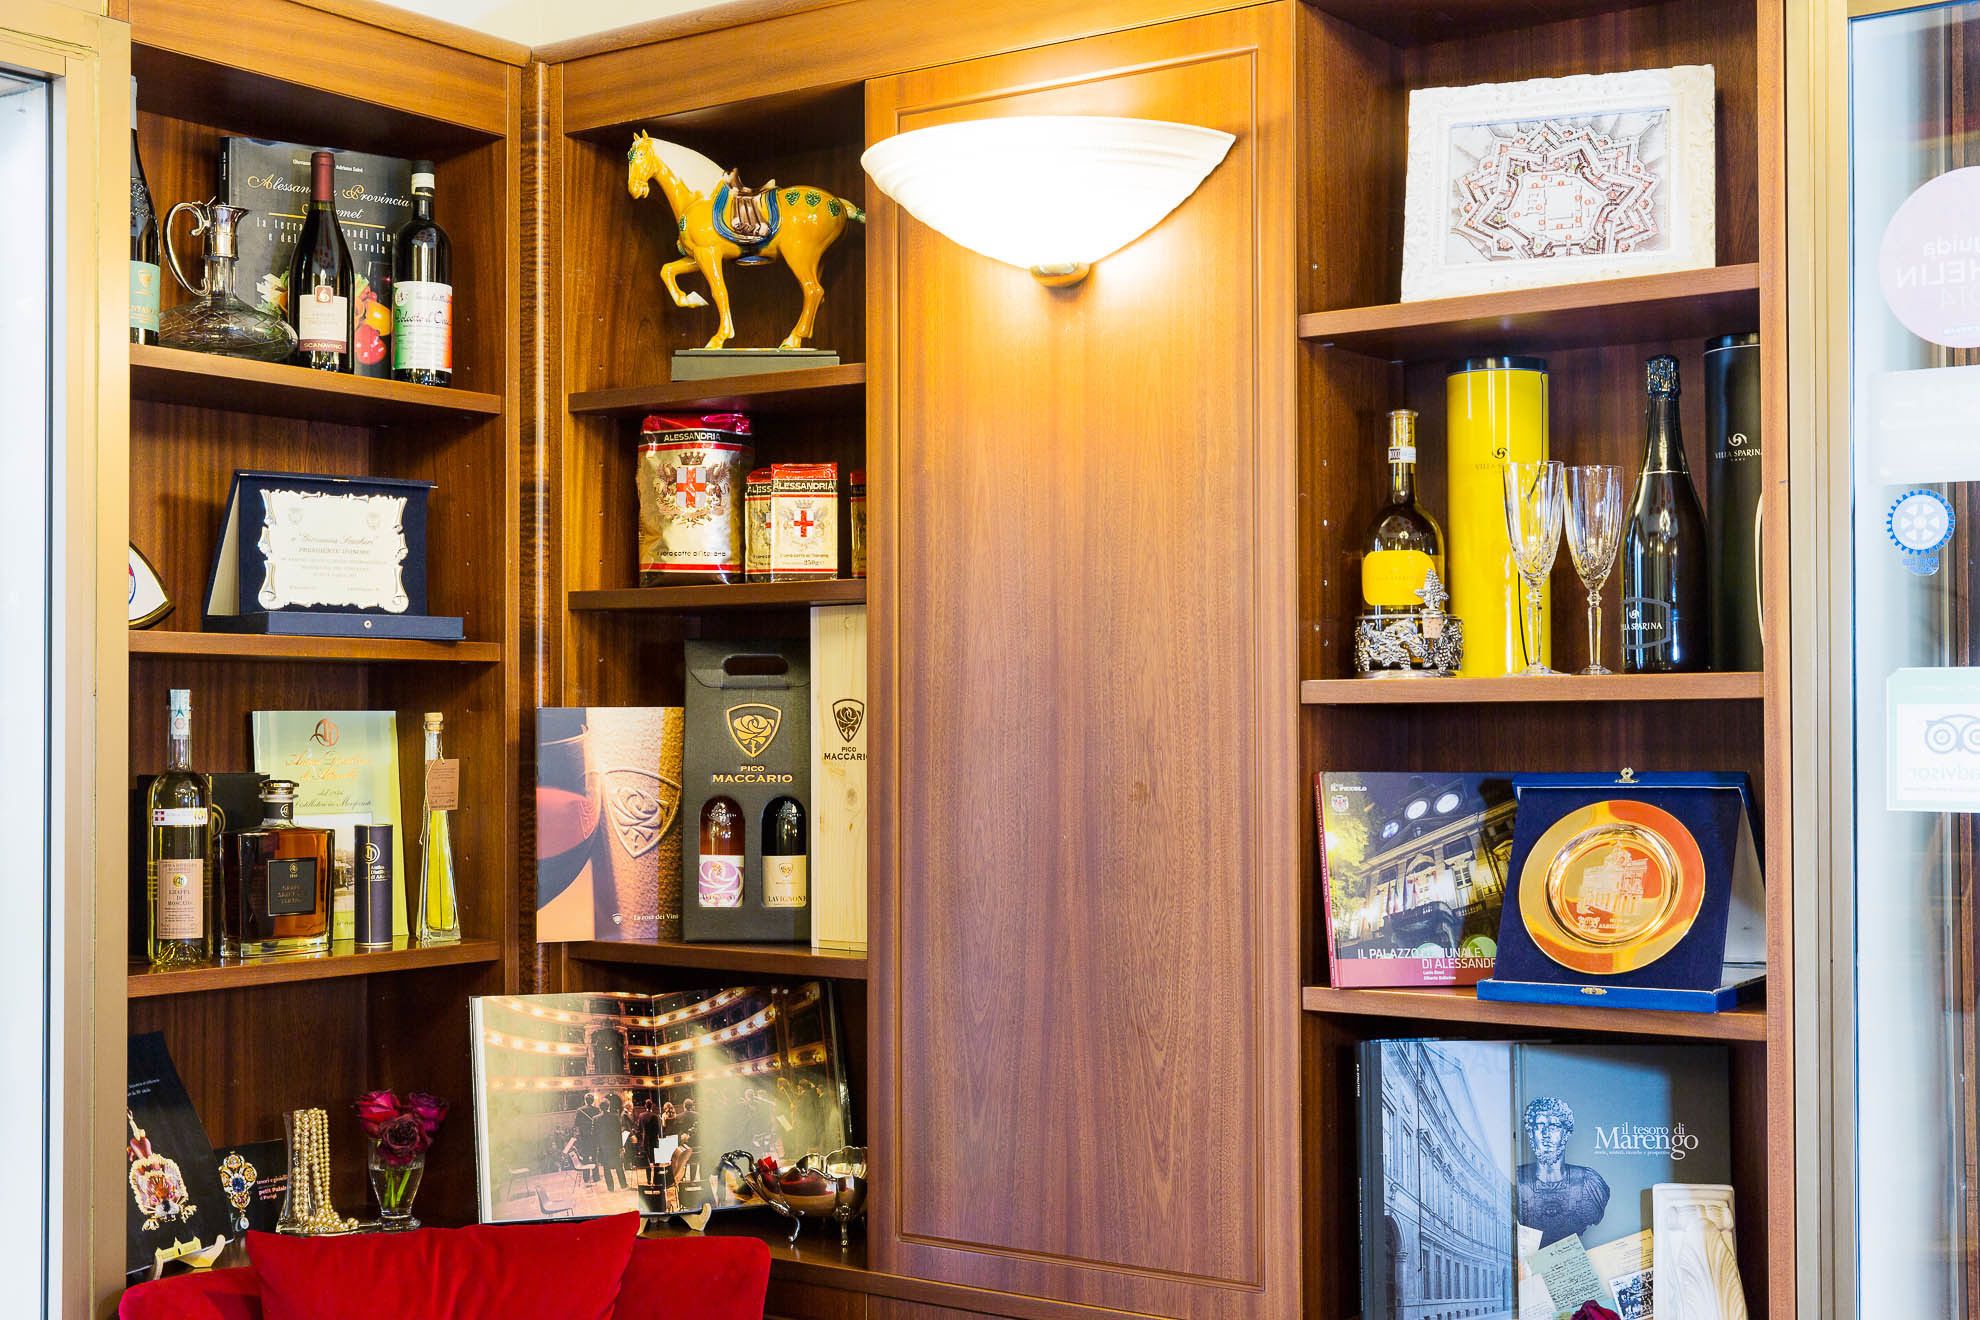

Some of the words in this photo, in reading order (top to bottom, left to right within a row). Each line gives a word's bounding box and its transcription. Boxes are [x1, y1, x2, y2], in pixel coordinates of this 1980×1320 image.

[342, 184, 409, 207] Provincia
[664, 432, 720, 442] ALESSANDRIA
[1733, 448, 1761, 457] SPARIN
[773, 481, 835, 491] ALESSANDRIA
[1631, 622, 1663, 631] SPARINA
[712, 774, 793, 783] MACCARIO
[1357, 948, 1368, 959] IL
[1369, 947, 1420, 960] PALAZZO
[1422, 958, 1433, 968] DI
[1435, 957, 1497, 969] ALESSANDR
[1621, 1121, 1629, 1135] il
[1633, 1125, 1669, 1135] tesoro
[1673, 1122, 1685, 1135] di
[1594, 1126, 1699, 1160] Marengo
